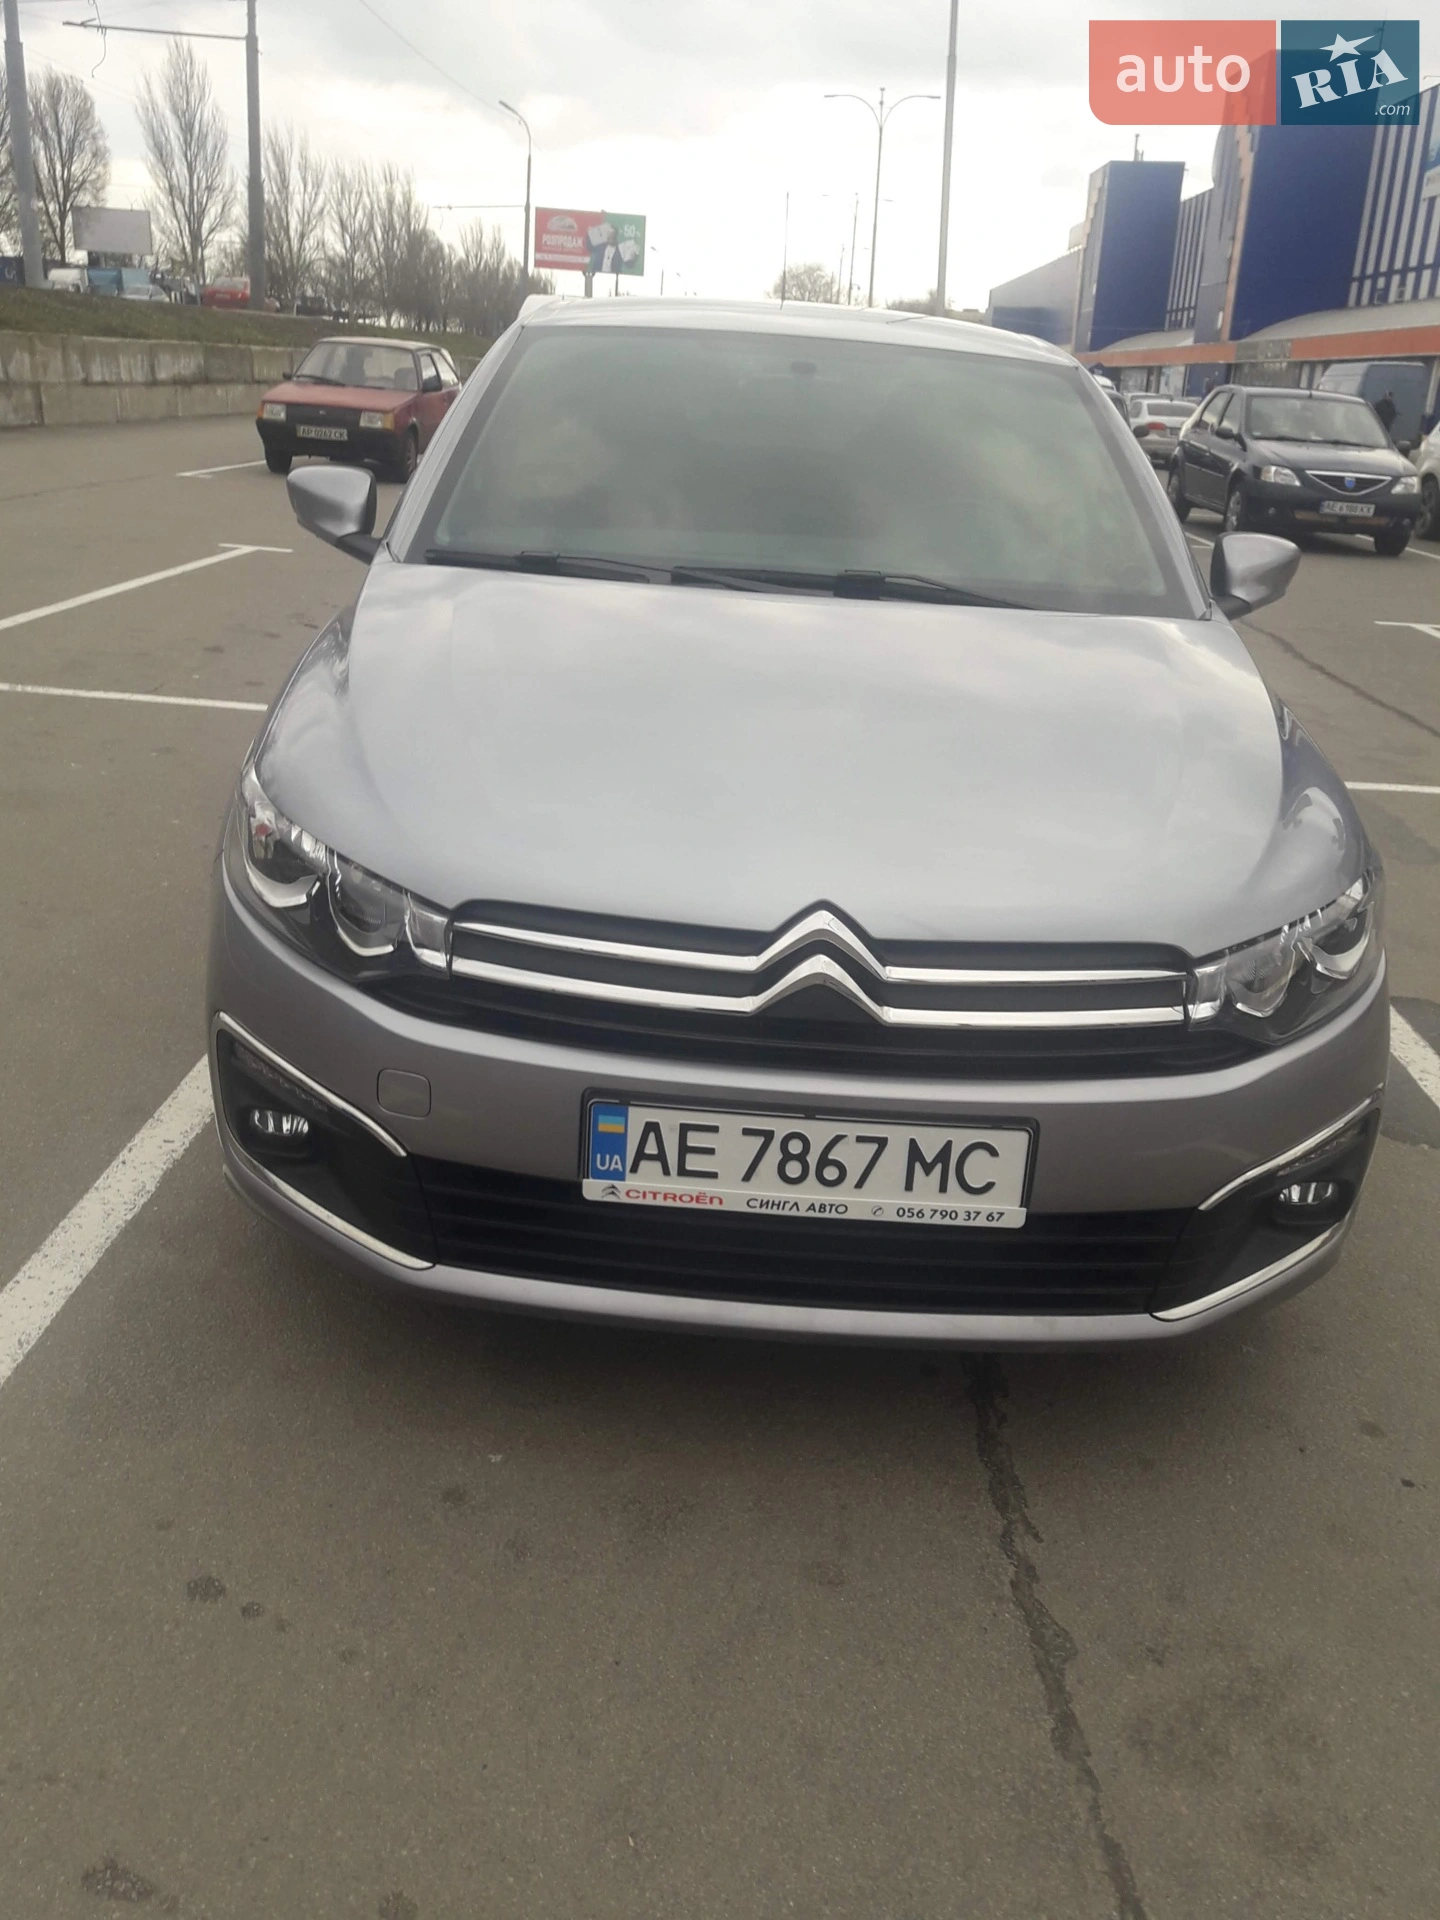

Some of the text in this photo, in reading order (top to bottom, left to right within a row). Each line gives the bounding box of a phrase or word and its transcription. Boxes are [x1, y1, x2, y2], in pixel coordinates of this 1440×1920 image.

[596, 1153, 623, 1172] UA
[629, 1121, 1000, 1195] AE 7867 MC
[746, 1198, 849, 1215] СИНГЛ АВТО
[896, 1207, 1005, 1223] 056 790 37 67
